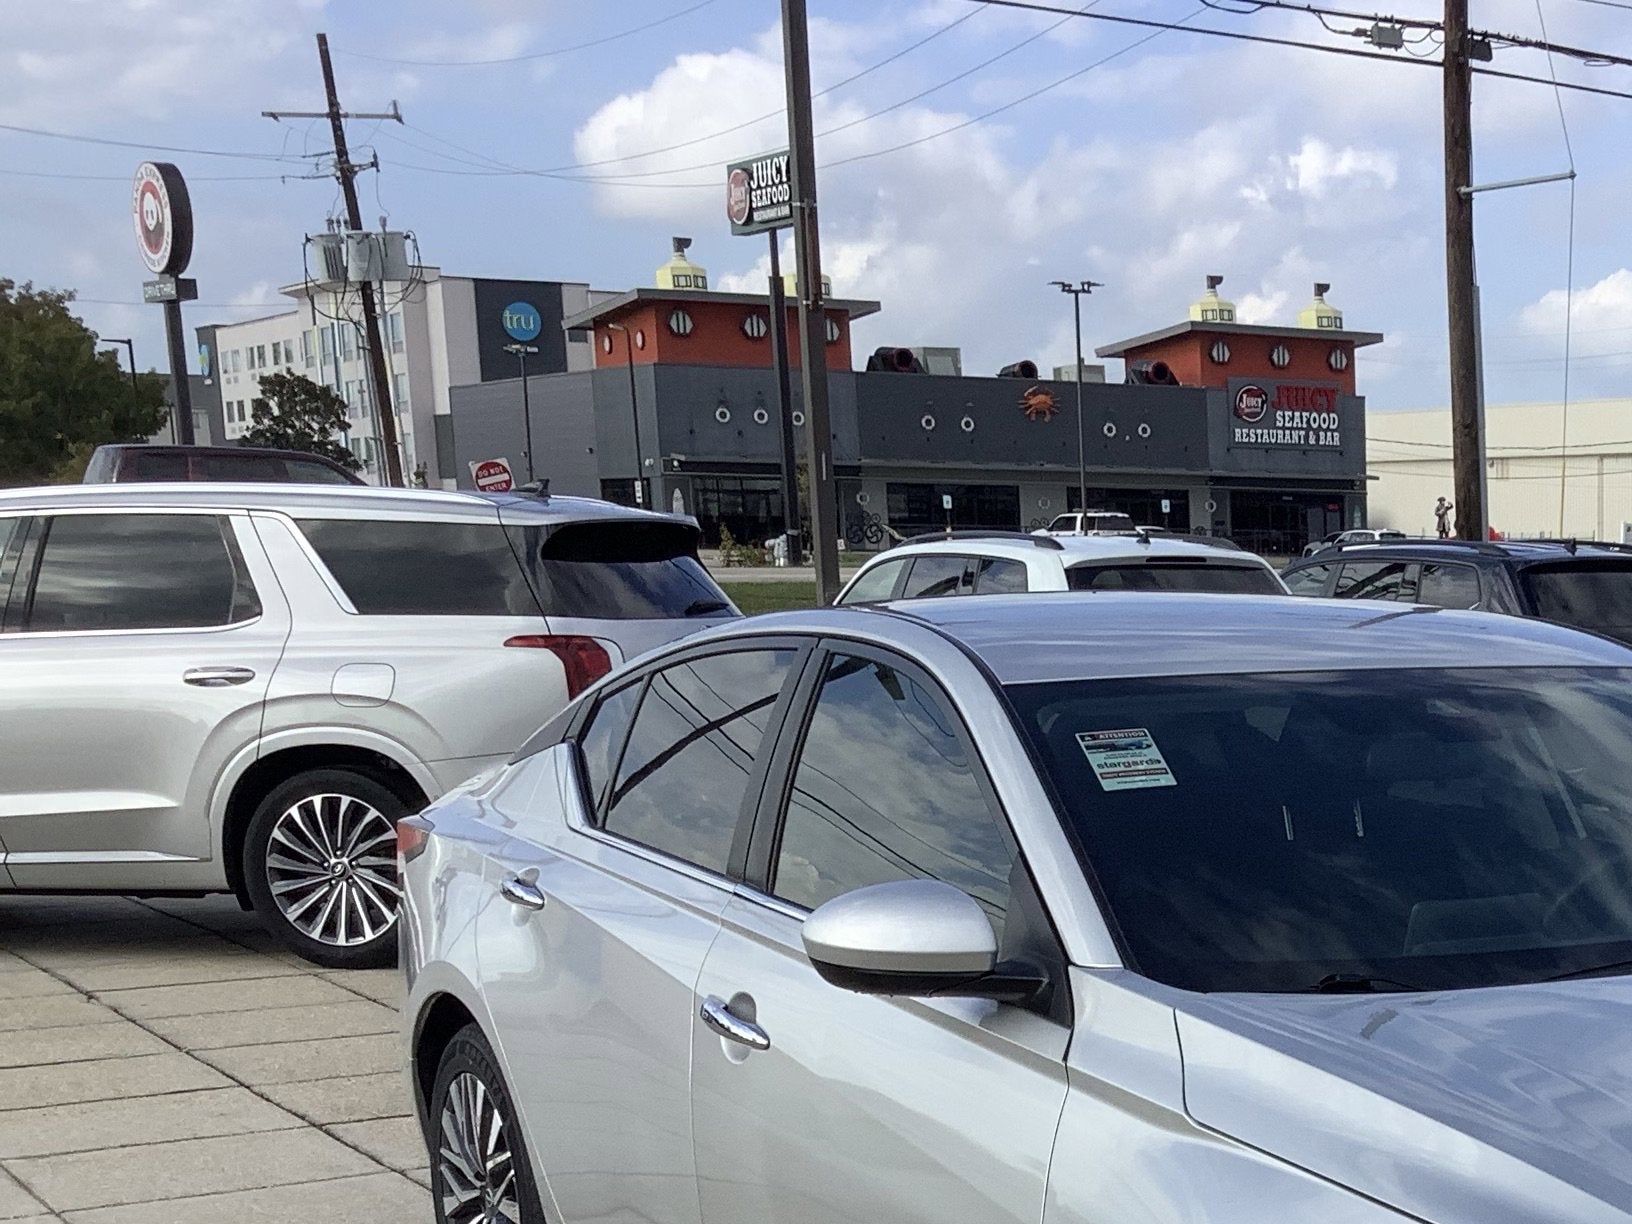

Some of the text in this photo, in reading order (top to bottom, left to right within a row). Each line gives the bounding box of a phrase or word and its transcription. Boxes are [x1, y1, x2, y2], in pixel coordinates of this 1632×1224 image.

[750, 155, 788, 189] JUICY
[751, 183, 790, 208] SEAFOOD
[503, 310, 535, 330] tru
[1271, 384, 1338, 412] JUICY
[1275, 410, 1340, 430] SEAFOOD
[1234, 428, 1341, 446] RESTAURANT & BAR
[1099, 731, 1146, 740] ATTENTION
